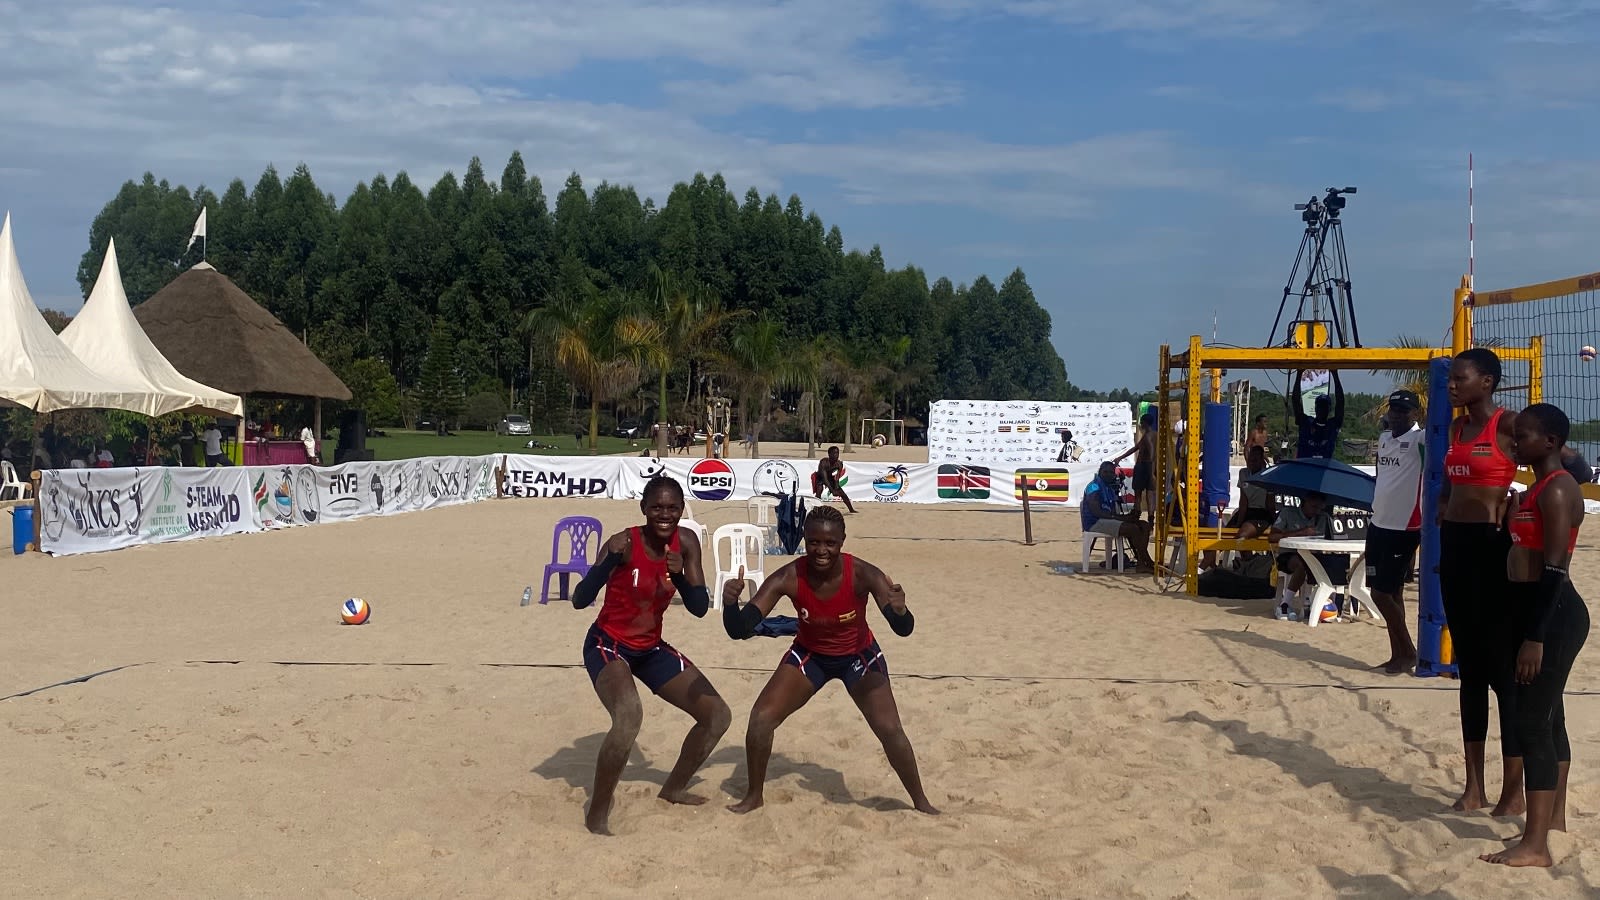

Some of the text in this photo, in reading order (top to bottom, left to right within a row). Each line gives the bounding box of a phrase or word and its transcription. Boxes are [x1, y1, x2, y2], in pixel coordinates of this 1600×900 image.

[1447, 465, 1470, 476] KEN
[566, 477, 608, 496] HD
[690, 476, 732, 487] PEPSI
[187, 486, 222, 508] S-TEAM
[221, 493, 240, 522] HD
[1333, 519, 1344, 533] 0
[632, 568, 639, 587] 1
